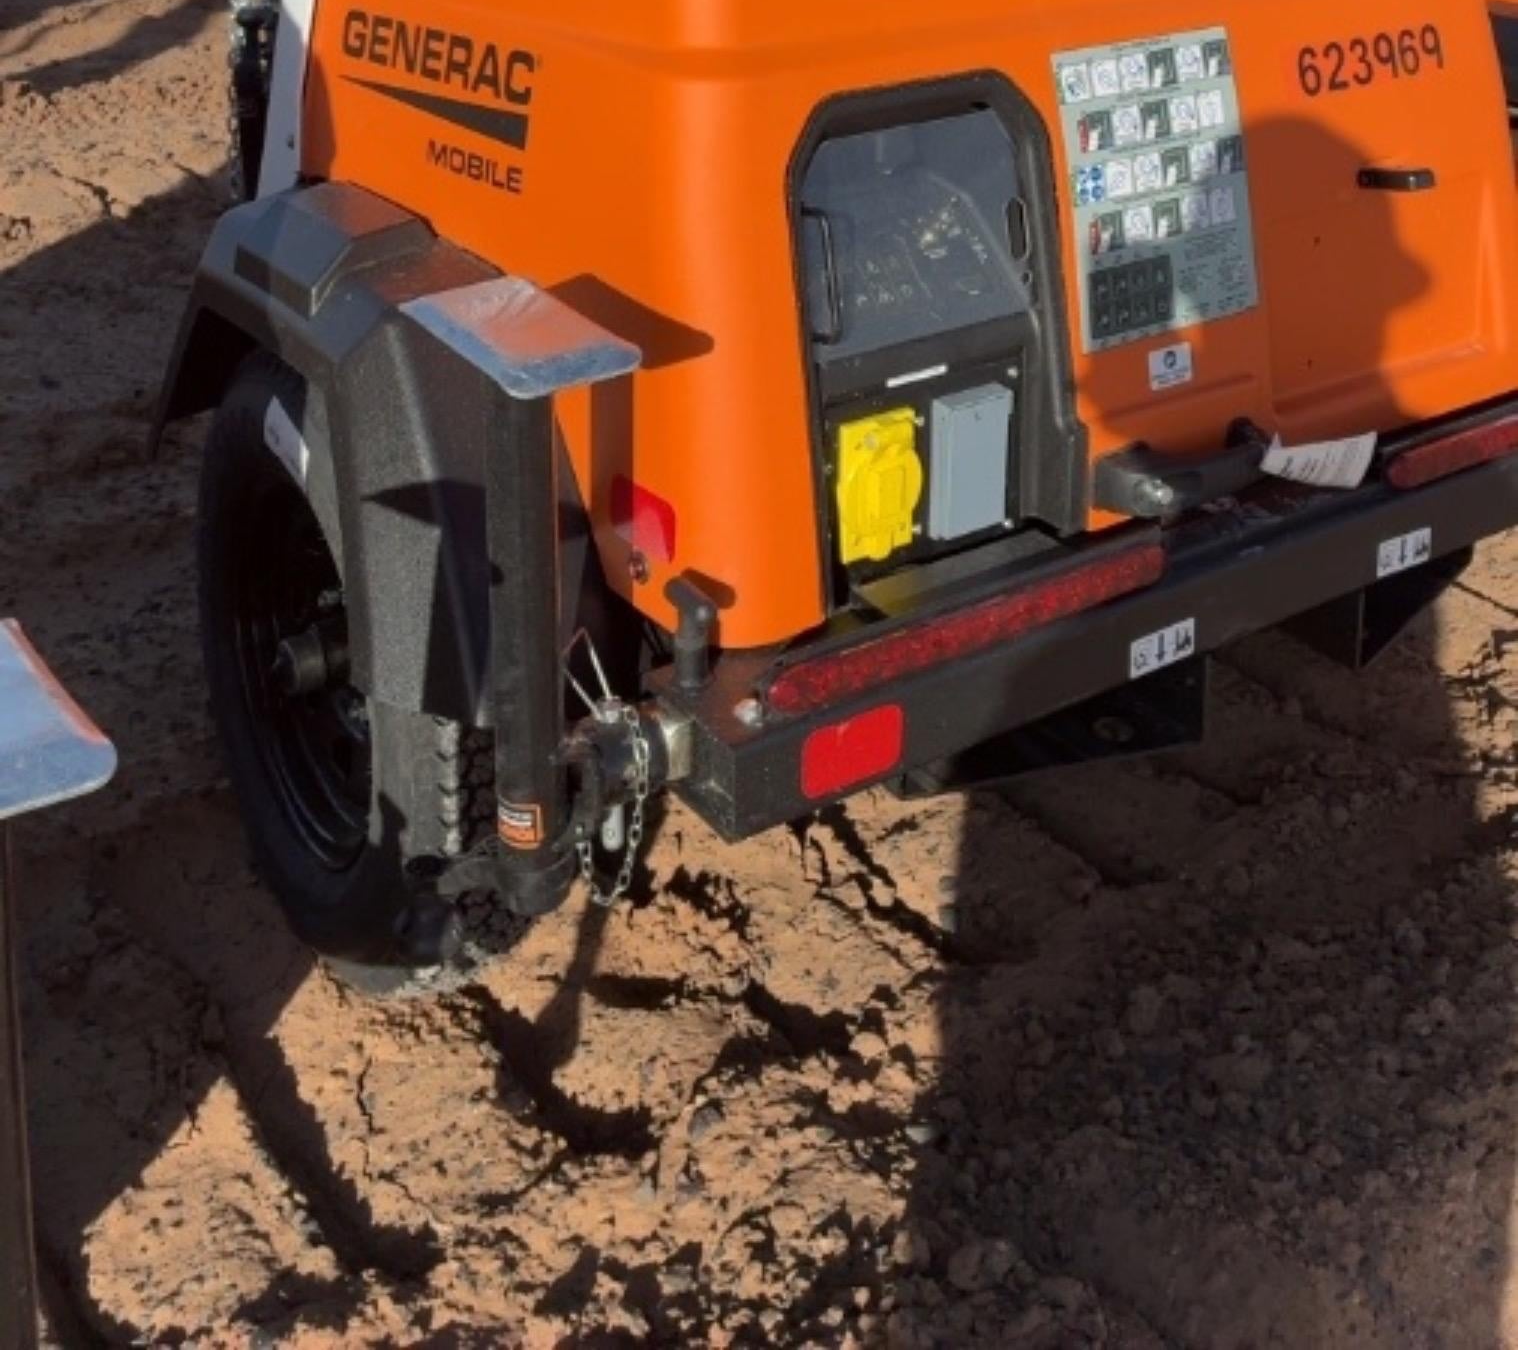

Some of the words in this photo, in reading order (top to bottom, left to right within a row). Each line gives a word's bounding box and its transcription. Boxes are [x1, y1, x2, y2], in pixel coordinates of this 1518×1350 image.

[342, 9, 535, 105] GENERAC
[1298, 24, 1443, 97] 623969
[426, 139, 523, 194] MOBILE
